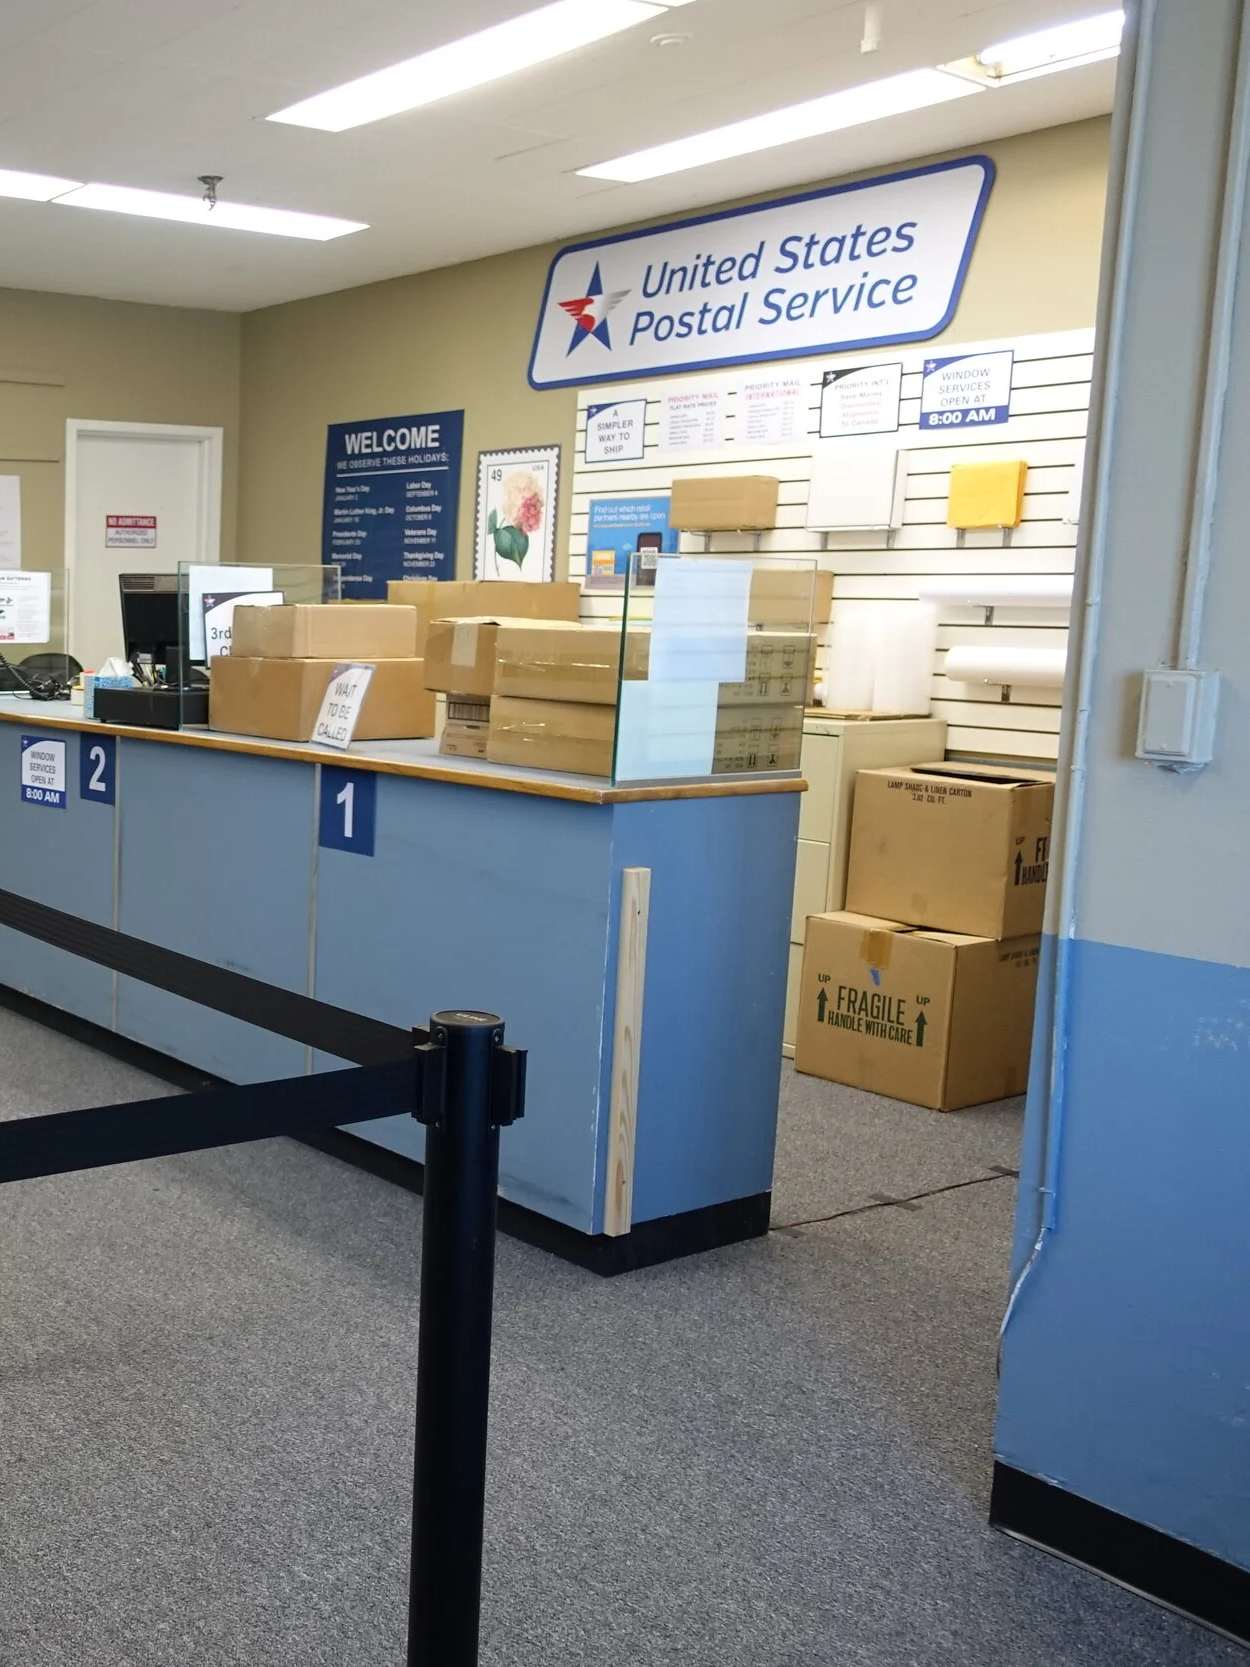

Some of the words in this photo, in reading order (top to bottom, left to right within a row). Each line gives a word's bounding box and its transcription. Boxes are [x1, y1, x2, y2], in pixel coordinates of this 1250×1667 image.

[642, 240, 766, 299] United
[773, 221, 918, 275] States
[629, 288, 748, 346] Postal
[758, 273, 918, 327] Service
[942, 368, 990, 381] WINDOW
[744, 382, 779, 391] PRIORITY
[835, 381, 868, 390] PRIORITY
[939, 381, 990, 395] SERVICES
[668, 394, 699, 403] PRIORITY
[941, 396, 969, 407] OPEN
[973, 394, 986, 403] AT
[612, 409, 618, 417] A
[929, 411, 962, 425] 8:00
[966, 408, 996, 422] AM
[597, 420, 634, 431] SIMPLER
[345, 424, 440, 455] WELCOME
[598, 434, 616, 442] WAY
[619, 432, 630, 440] TO
[604, 445, 623, 455] SHIP
[337, 461, 347, 469] WE
[350, 459, 381, 469] OBSERVE
[383, 456, 406, 466] THESE
[532, 464, 544, 472] USA
[491, 469, 502, 481] 49
[210, 626, 232, 640] 3rd
[335, 682, 357, 698] WAIT
[327, 703, 338, 718] TO
[338, 705, 352, 720] BE
[317, 722, 347, 742] CALLED
[30, 751, 55, 762] WINDOW
[30, 762, 56, 774] SERVICES
[89, 746, 106, 792] 2
[31, 774, 46, 785] OPEN
[47, 777, 54, 785] AT
[26, 787, 43, 800] 8:00
[44, 791, 59, 803] AM
[888, 781, 903, 789] LAMP
[905, 782, 923, 792] SHADE
[924, 785, 929, 793] &
[931, 785, 947, 795] LINEN
[949, 788, 972, 798] CARTON
[337, 782, 354, 838] 1
[818, 973, 831, 983] UP
[837, 985, 906, 1026] FRAGILE
[916, 995, 930, 1006] UP
[828, 1010, 863, 1033] HANDLE
[865, 1018, 887, 1039] WITH
[888, 1024, 913, 1045] CARE
